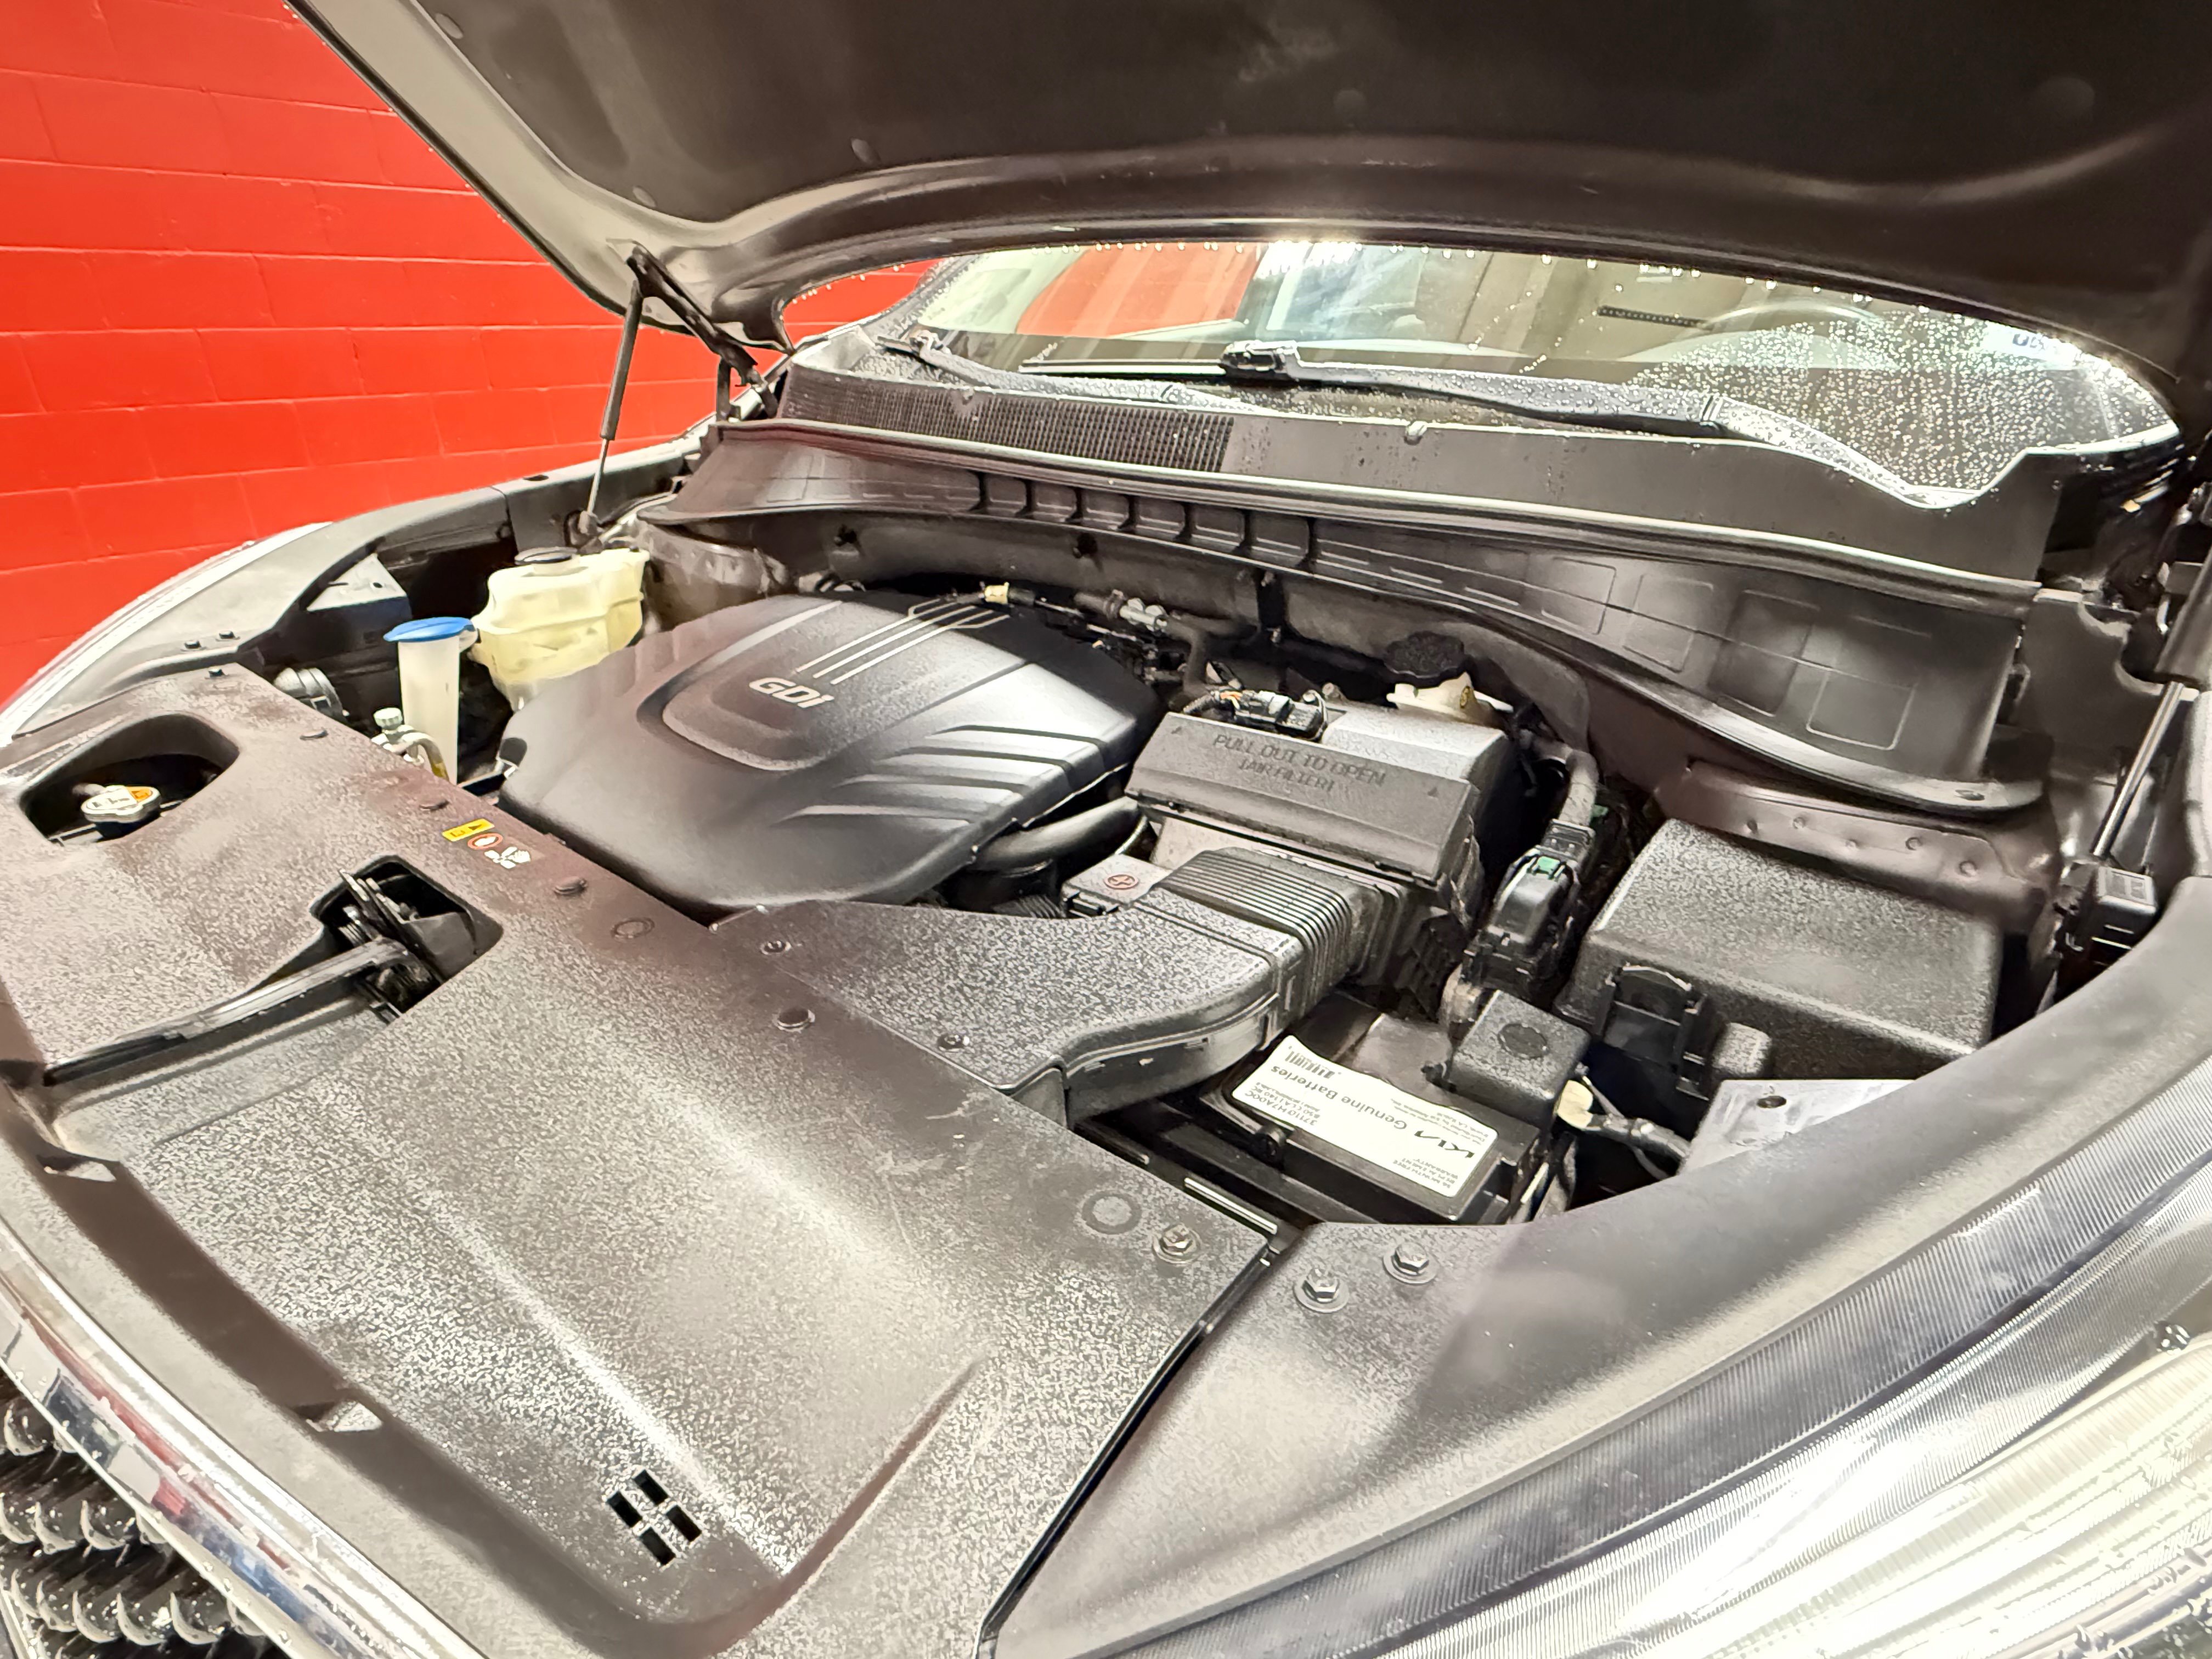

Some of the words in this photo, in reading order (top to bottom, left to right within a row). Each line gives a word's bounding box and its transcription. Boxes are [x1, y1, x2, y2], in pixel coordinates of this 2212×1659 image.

[1213, 734, 1256, 754] PULL
[1261, 744, 1296, 763] OUT
[1303, 754, 1329, 771] TO
[1330, 761, 1386, 787] OPEN
[1271, 1066, 1338, 1099] Batteries
[1287, 1110, 1317, 1126] 37110
[1341, 1097, 1407, 1129] Genuine
[1414, 1131, 1475, 1158] KIA
